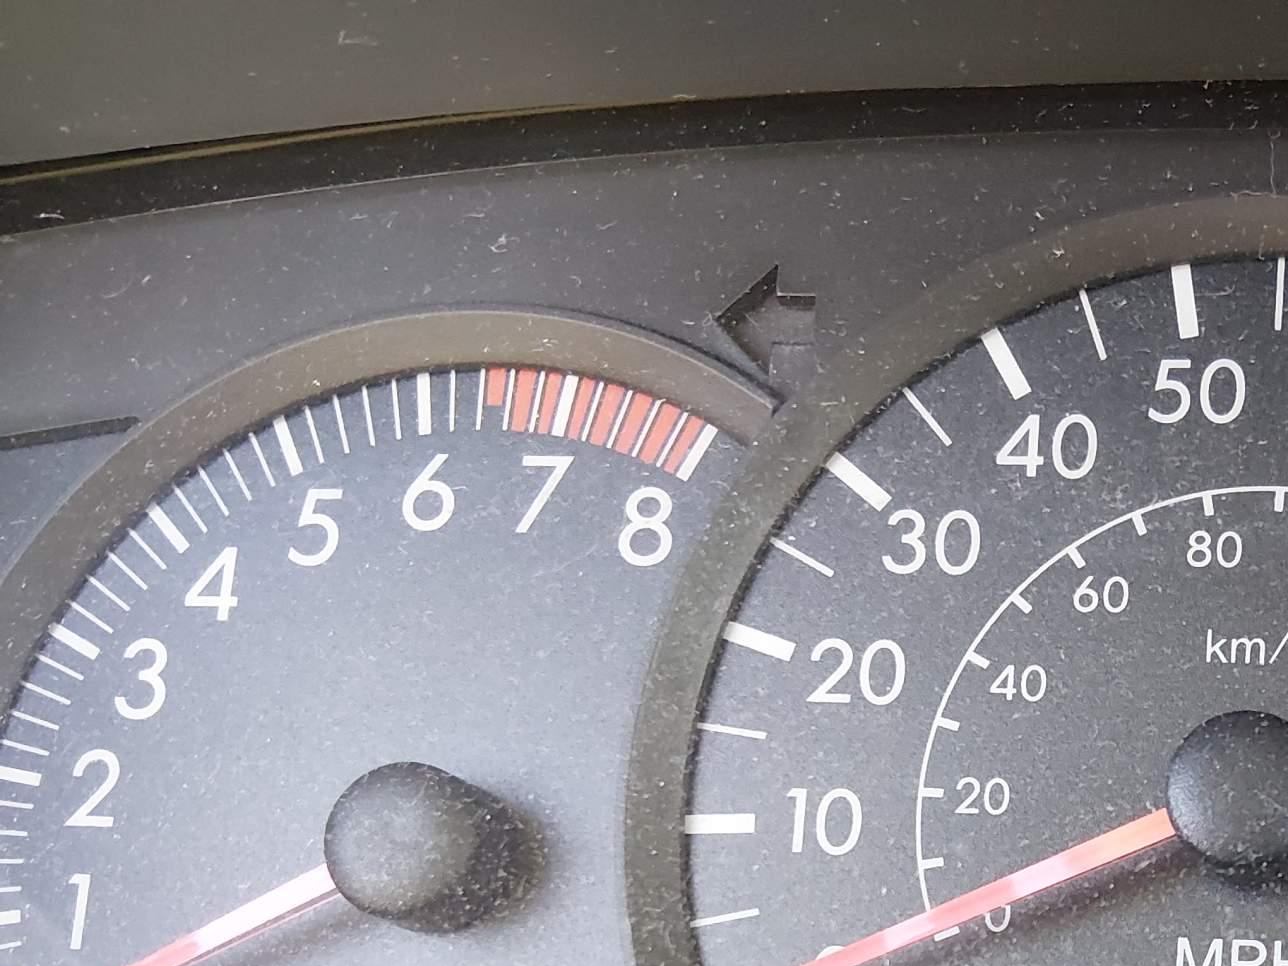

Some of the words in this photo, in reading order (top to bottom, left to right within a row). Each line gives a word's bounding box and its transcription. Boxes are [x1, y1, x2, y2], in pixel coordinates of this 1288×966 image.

[1147, 358, 1246, 424] 50
[996, 414, 1097, 479] 40
[402, 453, 455, 531] 6
[515, 455, 574, 533] 7
[287, 488, 343, 566] 5
[618, 487, 673, 566] 8
[882, 508, 981, 576] 30
[1186, 531, 1242, 568] 80
[184, 547, 239, 621] 4
[1073, 576, 1129, 614] 60
[114, 637, 168, 720] 3
[806, 638, 906, 705] 20
[990, 665, 1047, 701] 40
[64, 749, 121, 828] 2
[786, 788, 862, 856] 10
[955, 777, 1010, 816] 20
[67, 873, 91, 949] 1
